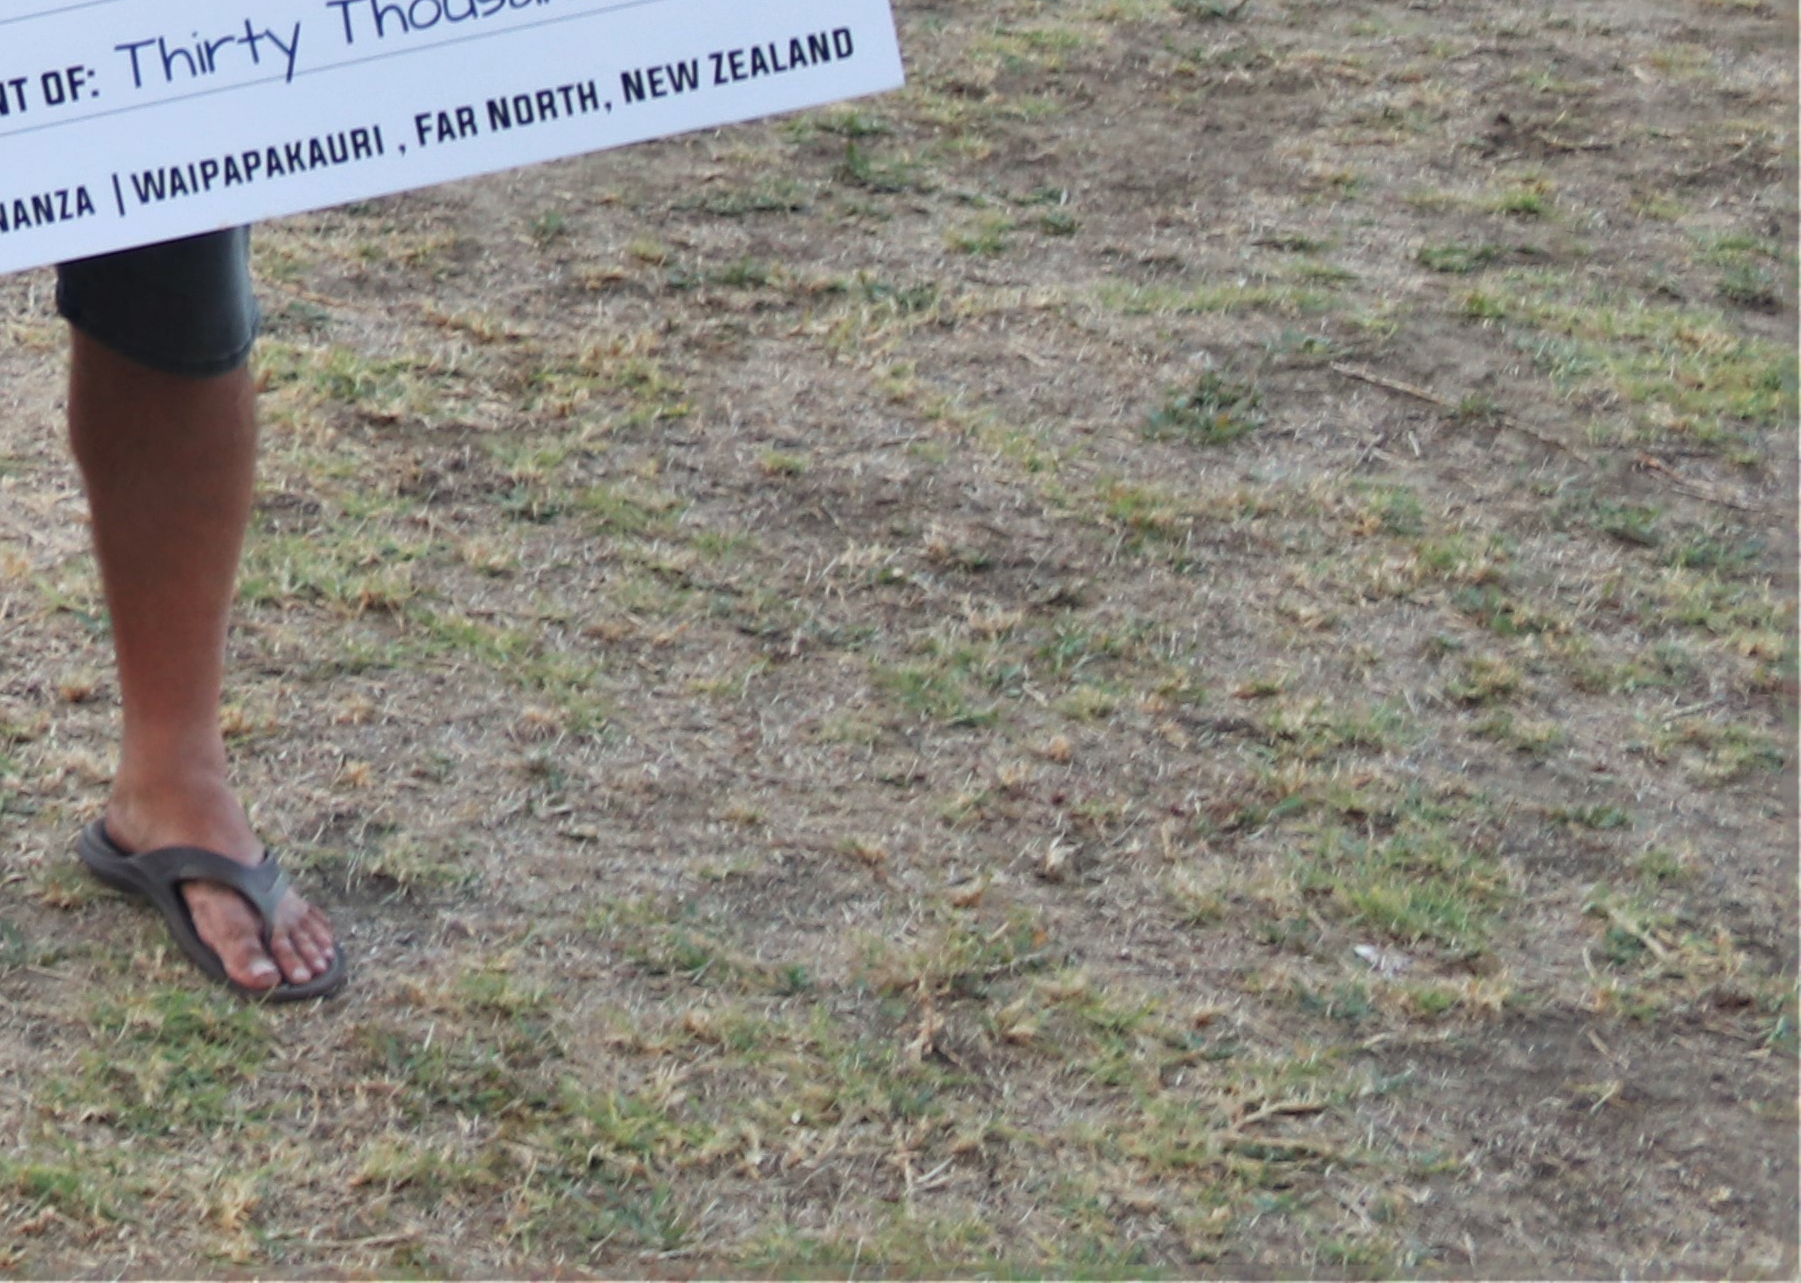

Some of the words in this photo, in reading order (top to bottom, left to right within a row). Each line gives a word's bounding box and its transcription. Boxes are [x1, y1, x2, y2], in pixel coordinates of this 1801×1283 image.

[41, 64, 100, 108] OF:
[114, 18, 302, 87] Thirty
[133, 125, 385, 206] WAIPAPAKAURI
[414, 110, 479, 150] FAR
[485, 79, 613, 135] NORTH,
[620, 57, 701, 107] NEW
[707, 25, 855, 89] ZEALAND
